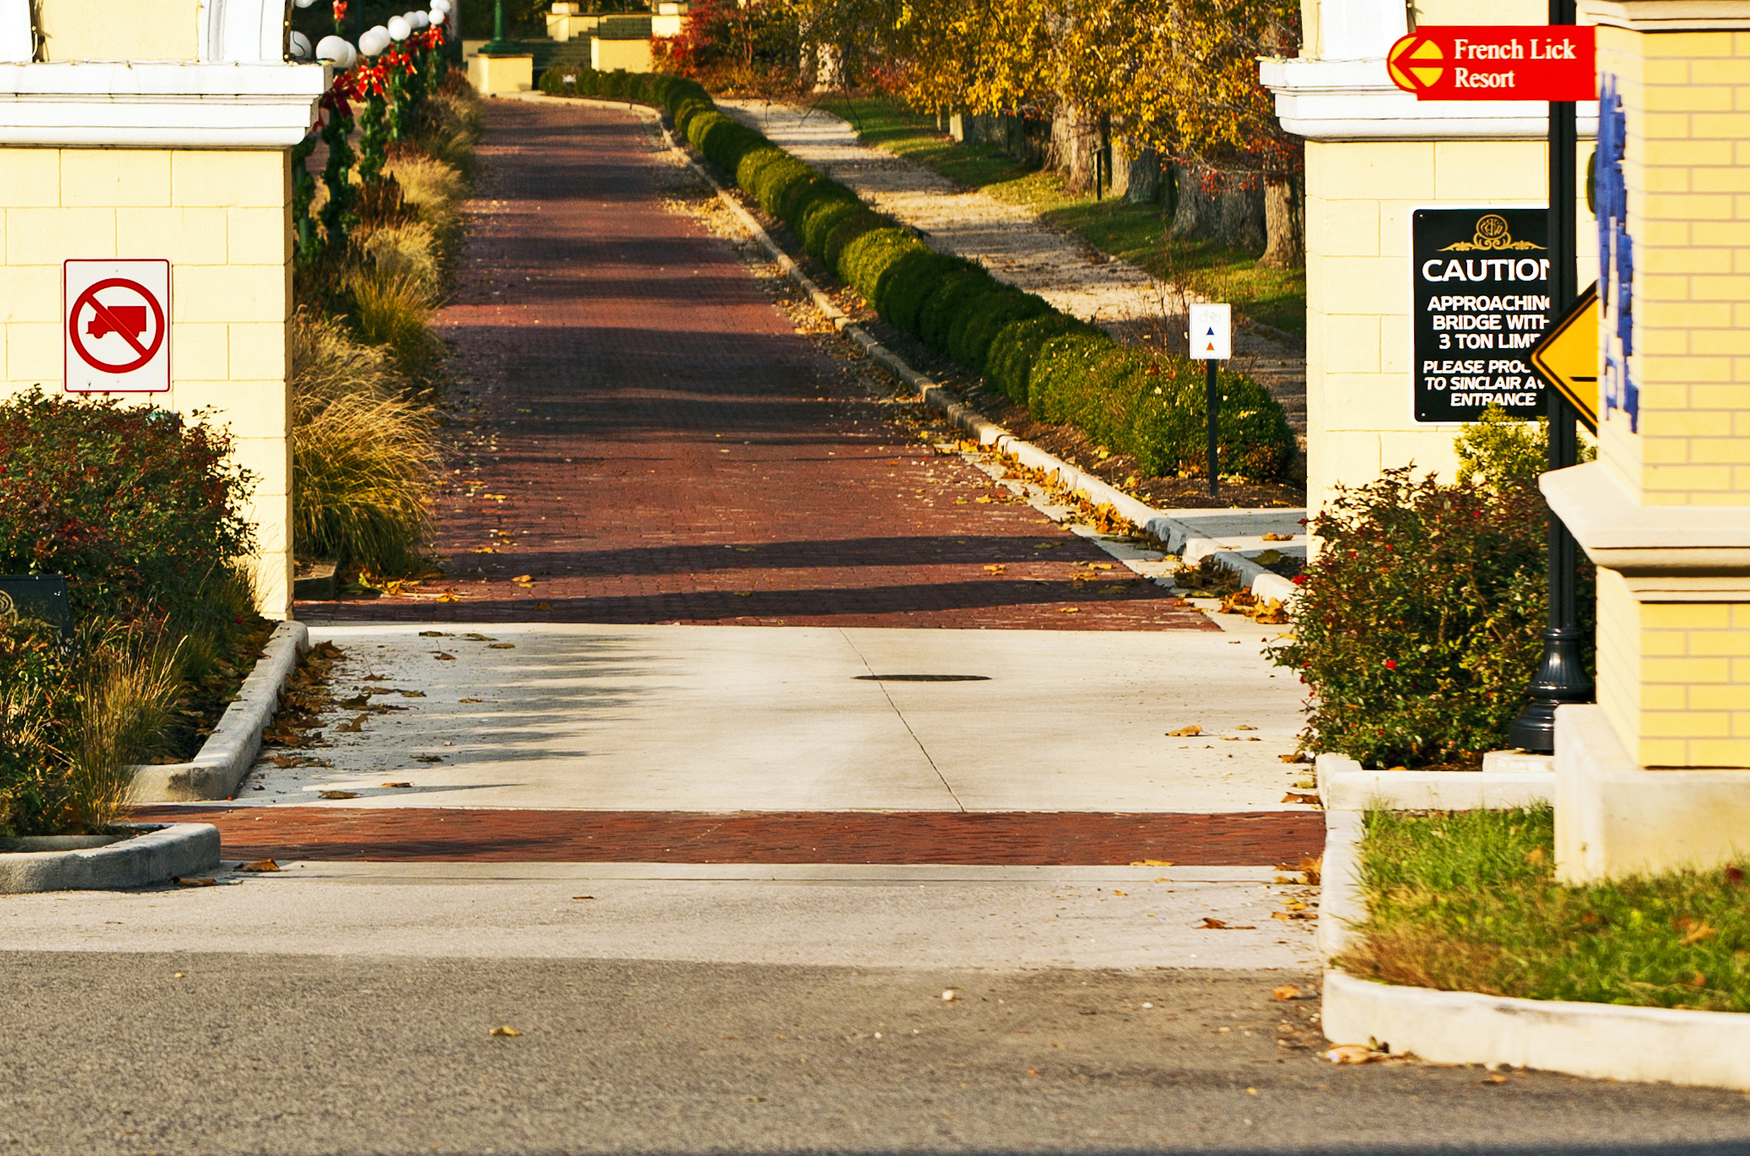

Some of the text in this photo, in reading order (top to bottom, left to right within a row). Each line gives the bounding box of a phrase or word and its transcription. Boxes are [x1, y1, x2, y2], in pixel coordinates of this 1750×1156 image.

[1454, 38, 1577, 60] French Lick
[1454, 66, 1516, 88] Resort
[1432, 314, 1503, 330] BRIDGE
[1438, 333, 1451, 350] 3
[1454, 333, 1494, 349] TON
[1422, 359, 1485, 374] PLEASE
[1424, 376, 1447, 390] TO
[1449, 376, 1522, 391] SINCLAIR
[1450, 392, 1537, 407] ENTRANCE
